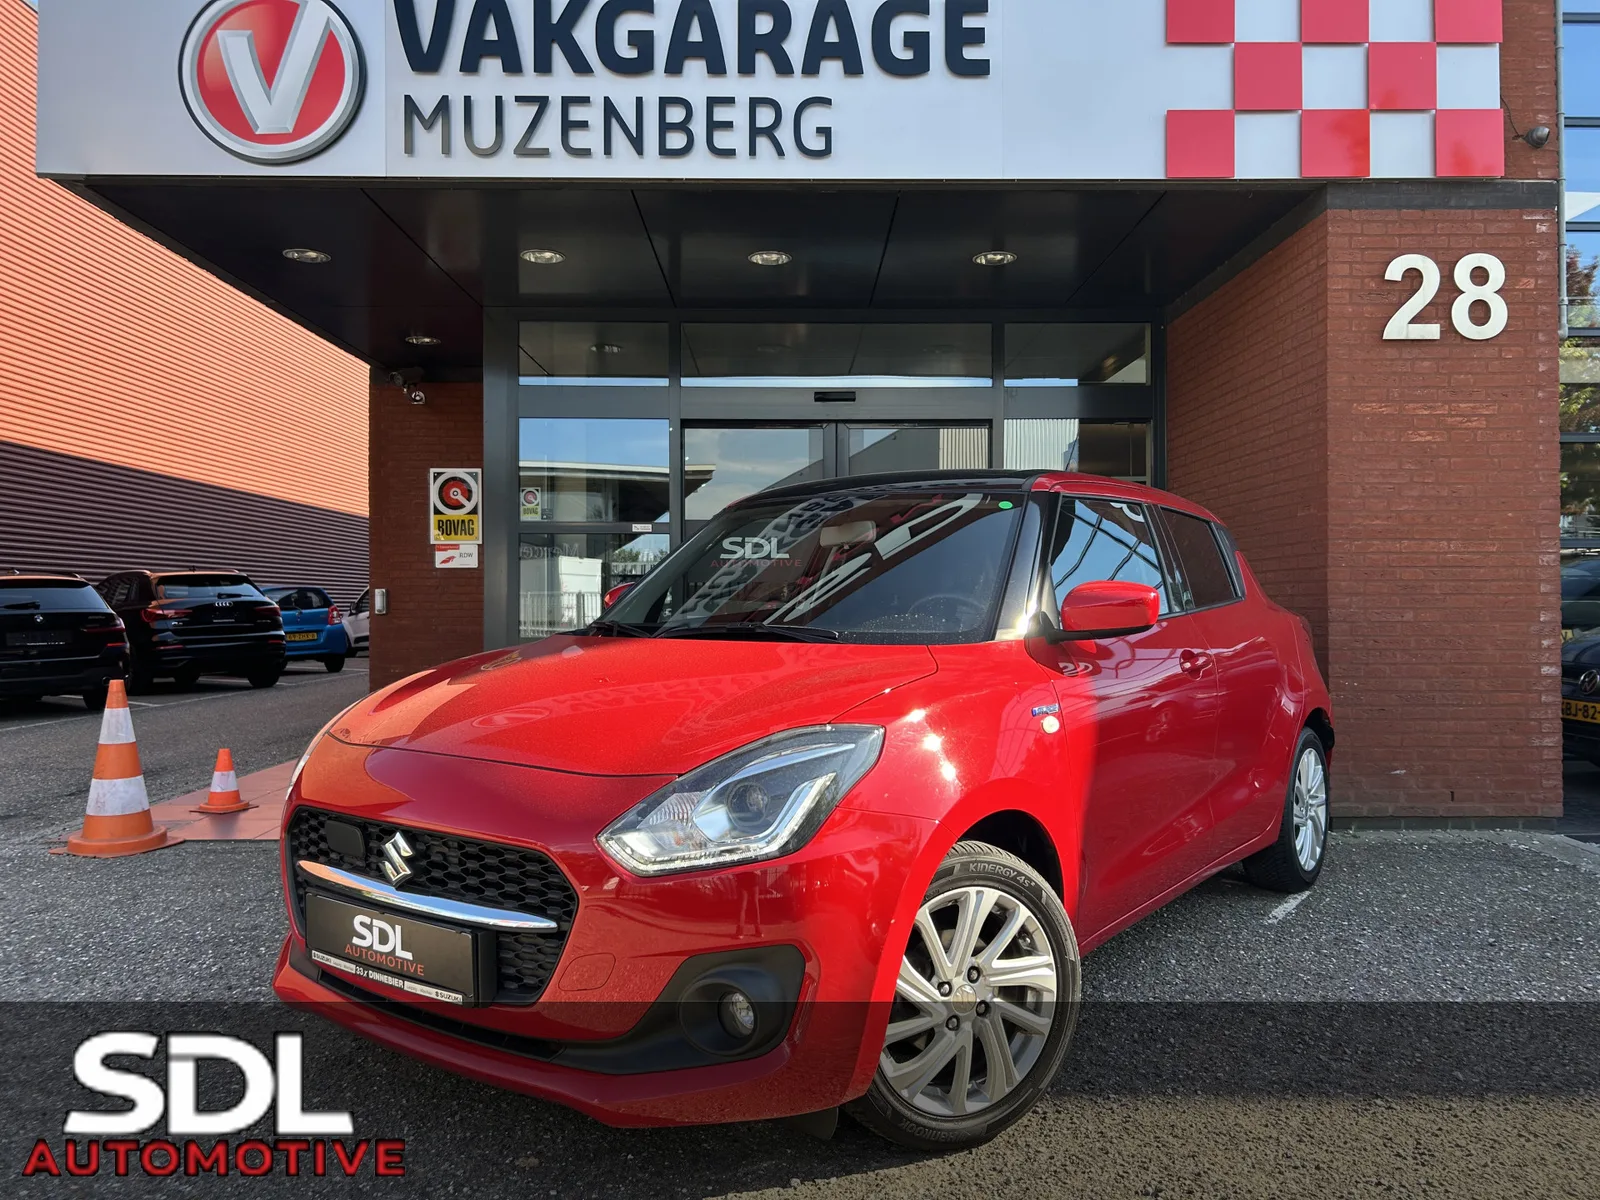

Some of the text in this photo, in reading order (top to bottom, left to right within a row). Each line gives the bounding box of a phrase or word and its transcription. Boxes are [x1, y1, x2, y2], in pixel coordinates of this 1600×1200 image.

[393, 0, 990, 76] VAKGARAGE
[403, 94, 833, 158] MUZENBERG
[1382, 253, 1508, 340] 28
[437, 518, 475, 537] BOVAG
[710, 559, 803, 568] AUTOMOTIVE
[720, 536, 790, 559] SDL
[969, 862, 1018, 878] KINERGY
[352, 914, 413, 960] SDL
[345, 943, 424, 976] AUTOMOTIVE
